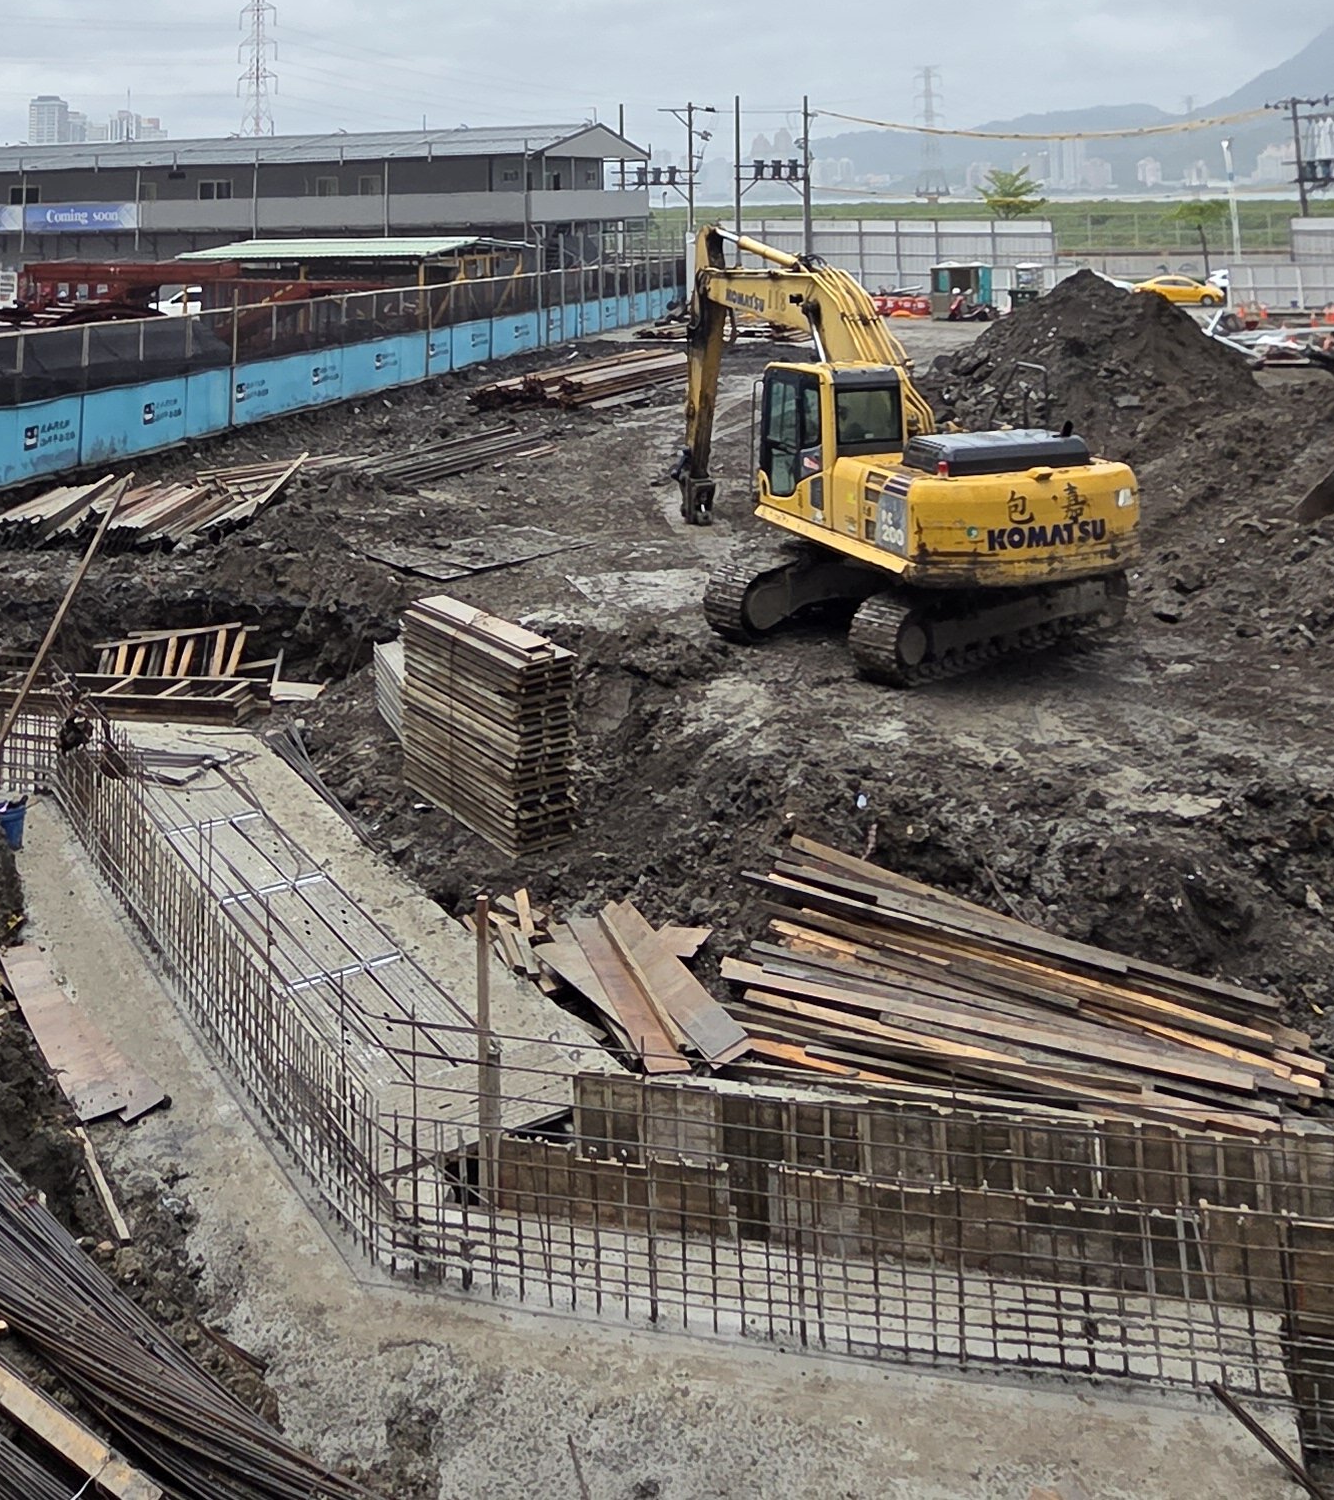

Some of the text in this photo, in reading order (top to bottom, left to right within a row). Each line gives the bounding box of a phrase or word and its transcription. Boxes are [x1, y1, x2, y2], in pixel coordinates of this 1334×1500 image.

[46, 208, 118, 224] Coming soon
[725, 287, 765, 312] KOMATSU
[767, 289, 787, 312] 118
[1007, 490, 1034, 525] 包
[881, 524, 906, 547] 200
[987, 518, 1107, 551] KOMATSU
